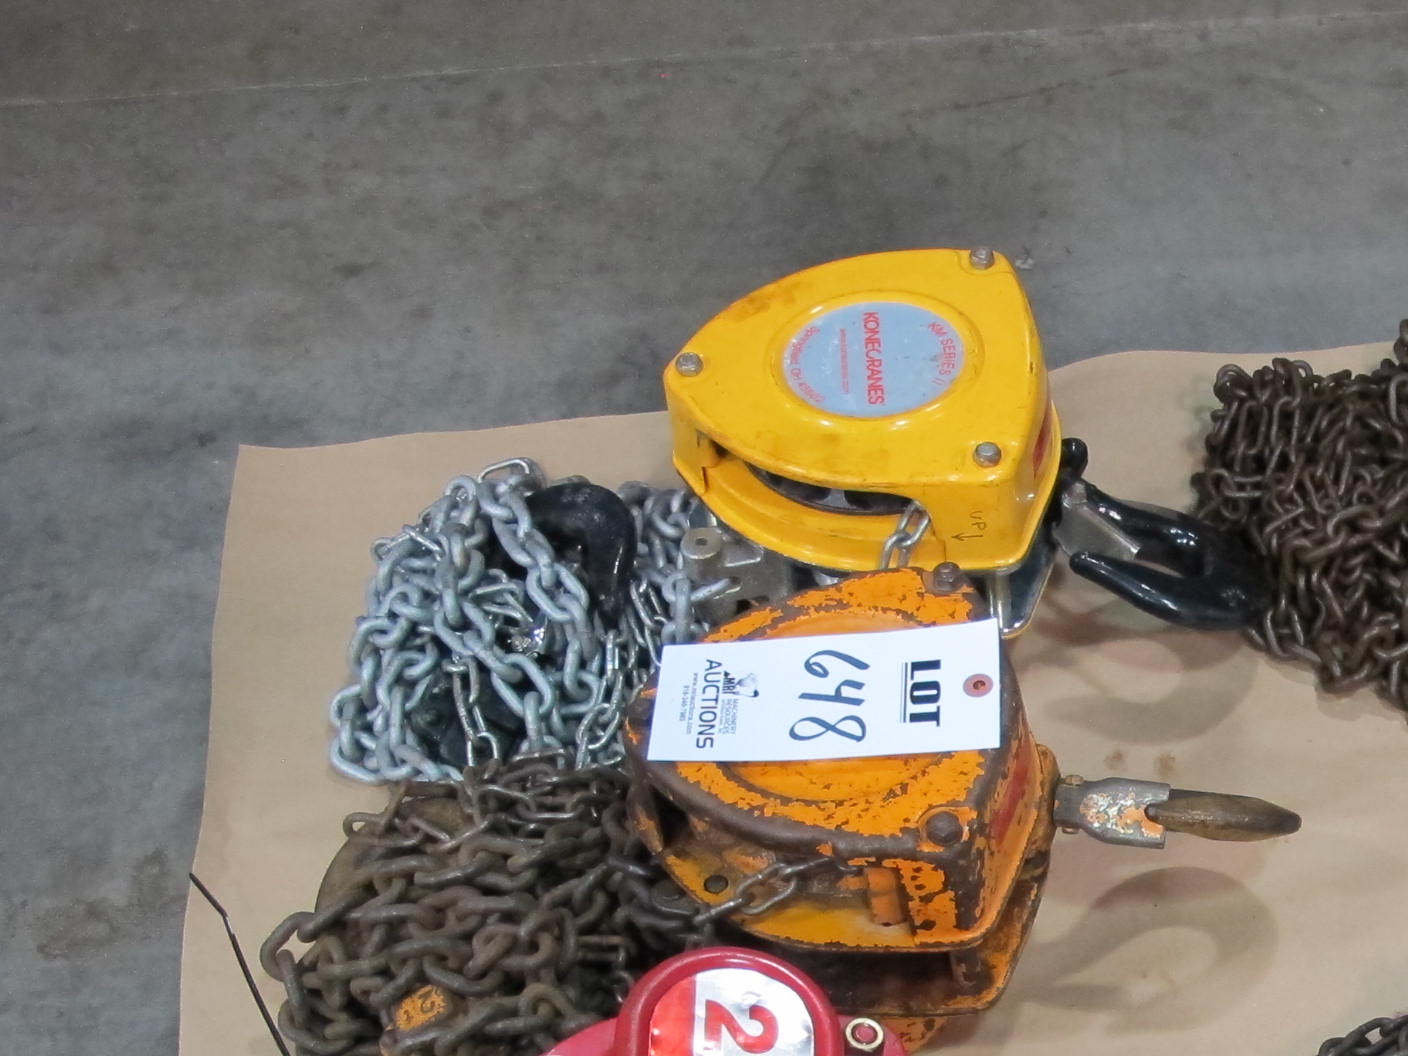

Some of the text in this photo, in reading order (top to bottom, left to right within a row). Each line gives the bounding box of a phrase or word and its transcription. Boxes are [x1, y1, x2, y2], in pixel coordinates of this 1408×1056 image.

[863, 311, 885, 405] KONECRANES
[938, 336, 957, 376] SERIES
[969, 510, 988, 531] UP
[696, 659, 723, 749] AUCTIONS
[788, 649, 871, 743] 648
[908, 659, 942, 728] LOT
[704, 999, 779, 1054] 2
